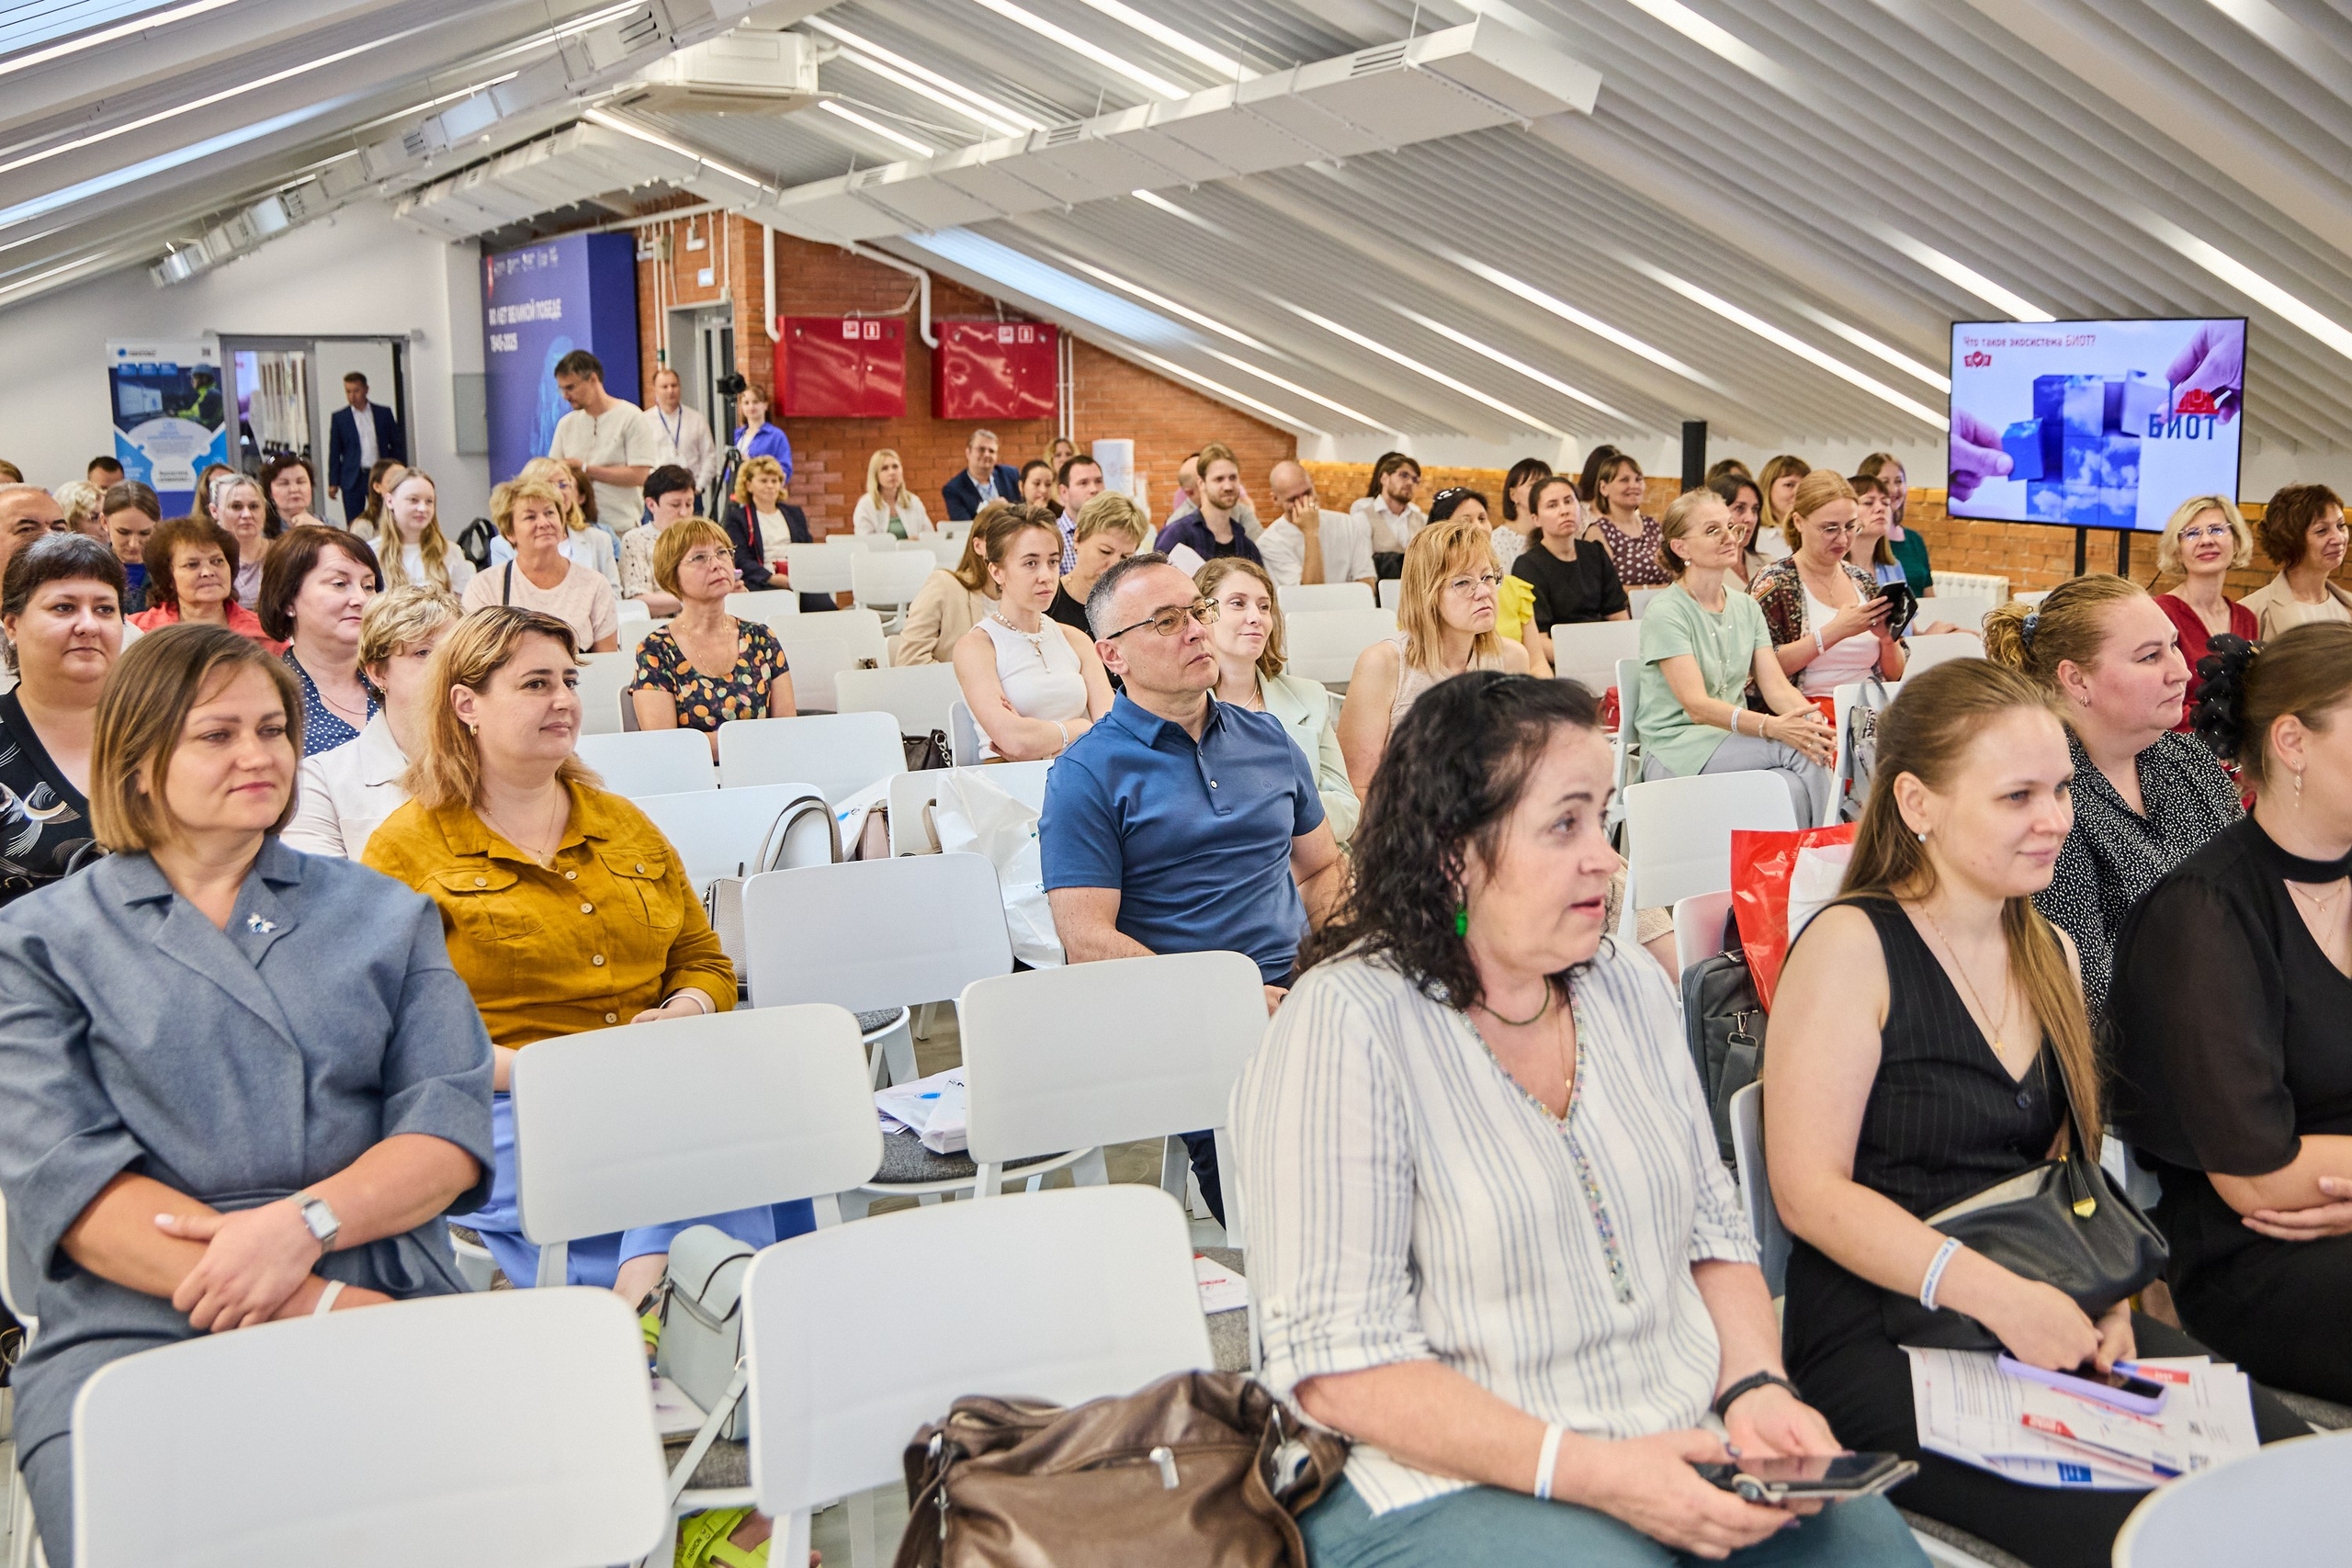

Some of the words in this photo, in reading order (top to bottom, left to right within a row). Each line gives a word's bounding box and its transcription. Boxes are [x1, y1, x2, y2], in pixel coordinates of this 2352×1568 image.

[536, 299, 561, 321] ПОБЕДЕ
[1963, 335, 1979, 347] Что
[1982, 337, 2007, 347] такое
[2009, 337, 2063, 347] экосистема
[2065, 333, 2097, 347] БИОТ?
[2149, 413, 2219, 439] БИОТ
